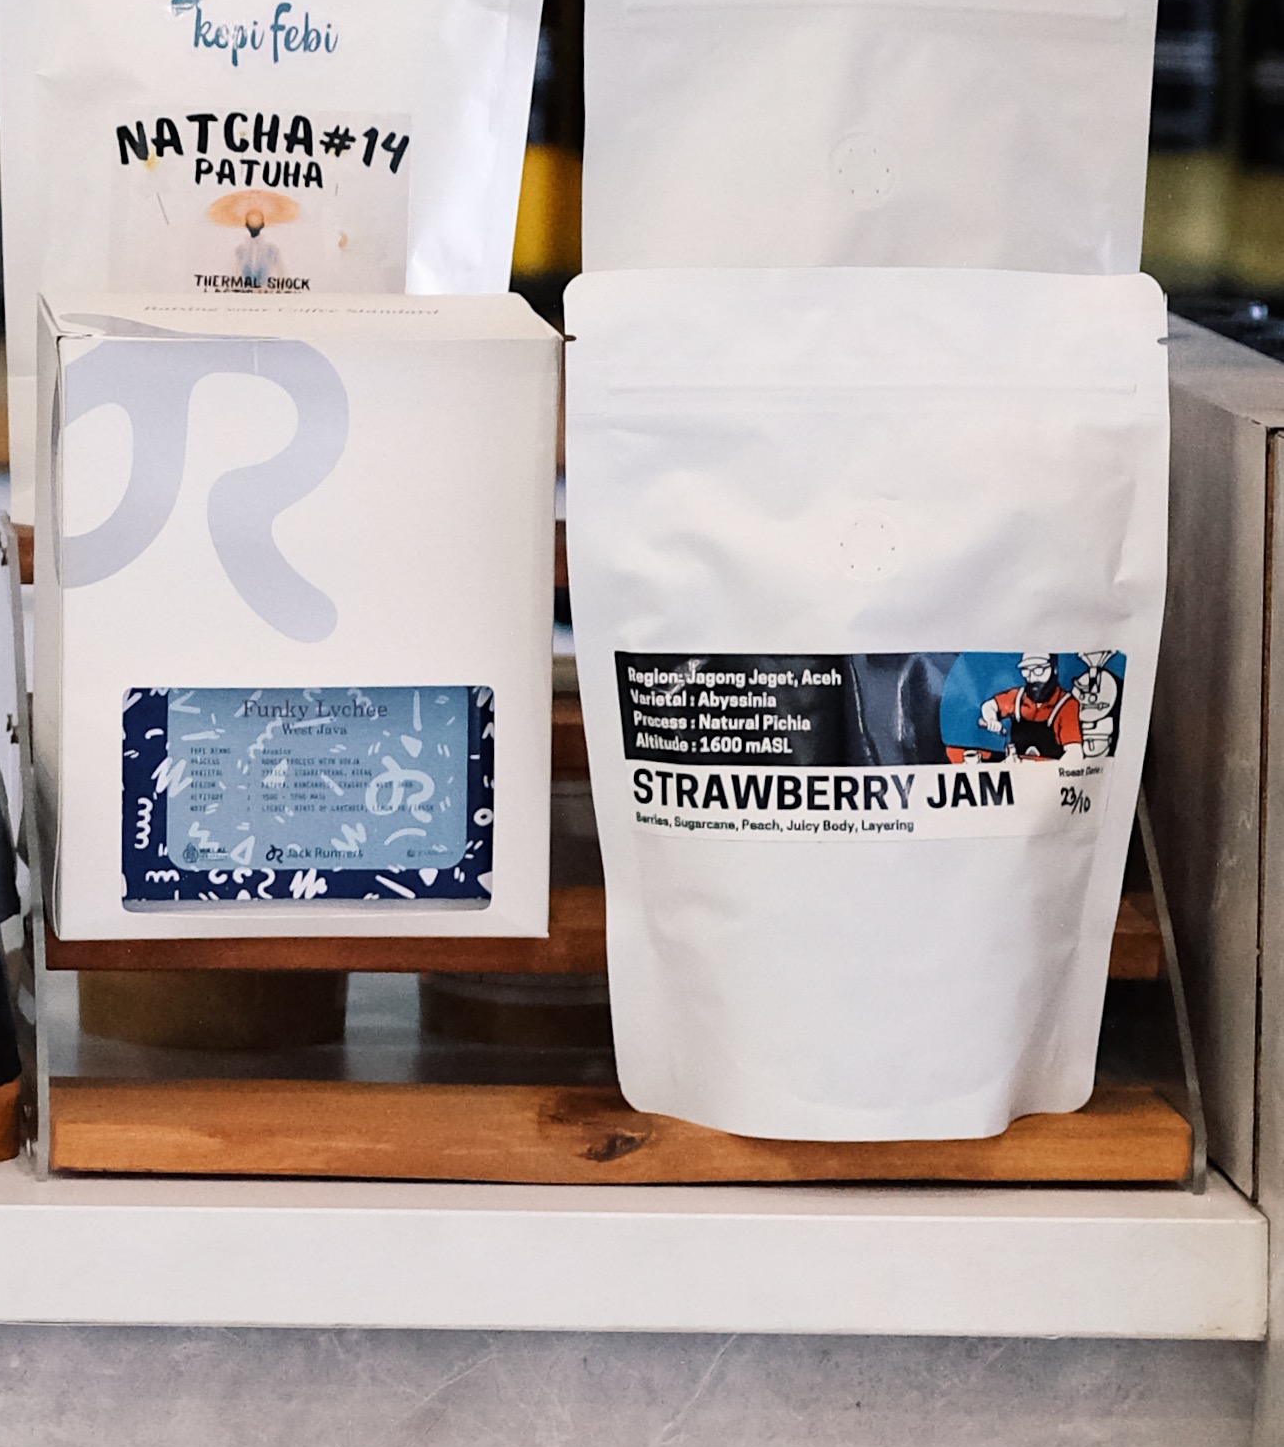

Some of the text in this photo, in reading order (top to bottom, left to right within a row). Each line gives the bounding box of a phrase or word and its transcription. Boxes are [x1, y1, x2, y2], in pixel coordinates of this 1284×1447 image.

[194, 2, 339, 67] kopi febi
[195, 157, 324, 189] PATUHA
[194, 274, 311, 290] THERMAL SHOCK
[687, 668, 746, 688] Jagong
[802, 669, 842, 686] Aceh
[242, 699, 388, 722] Funky Lychee
[630, 689, 687, 708] Varietal
[698, 691, 777, 711] Abyssinia
[282, 723, 348, 736] West Java
[633, 710, 688, 730] Process
[699, 714, 760, 731] Natural
[763, 714, 811, 731] Pichia
[636, 732, 689, 752] Altitude
[700, 736, 742, 753] 1600
[745, 737, 793, 754] mASL
[633, 768, 1015, 811] STRAWBERRY JAM
[742, 818, 784, 833] Peach,
[786, 819, 820, 834] Juicy
[823, 819, 858, 833] Body,
[861, 819, 914, 834] Layering
[287, 846, 312, 859] Jack
